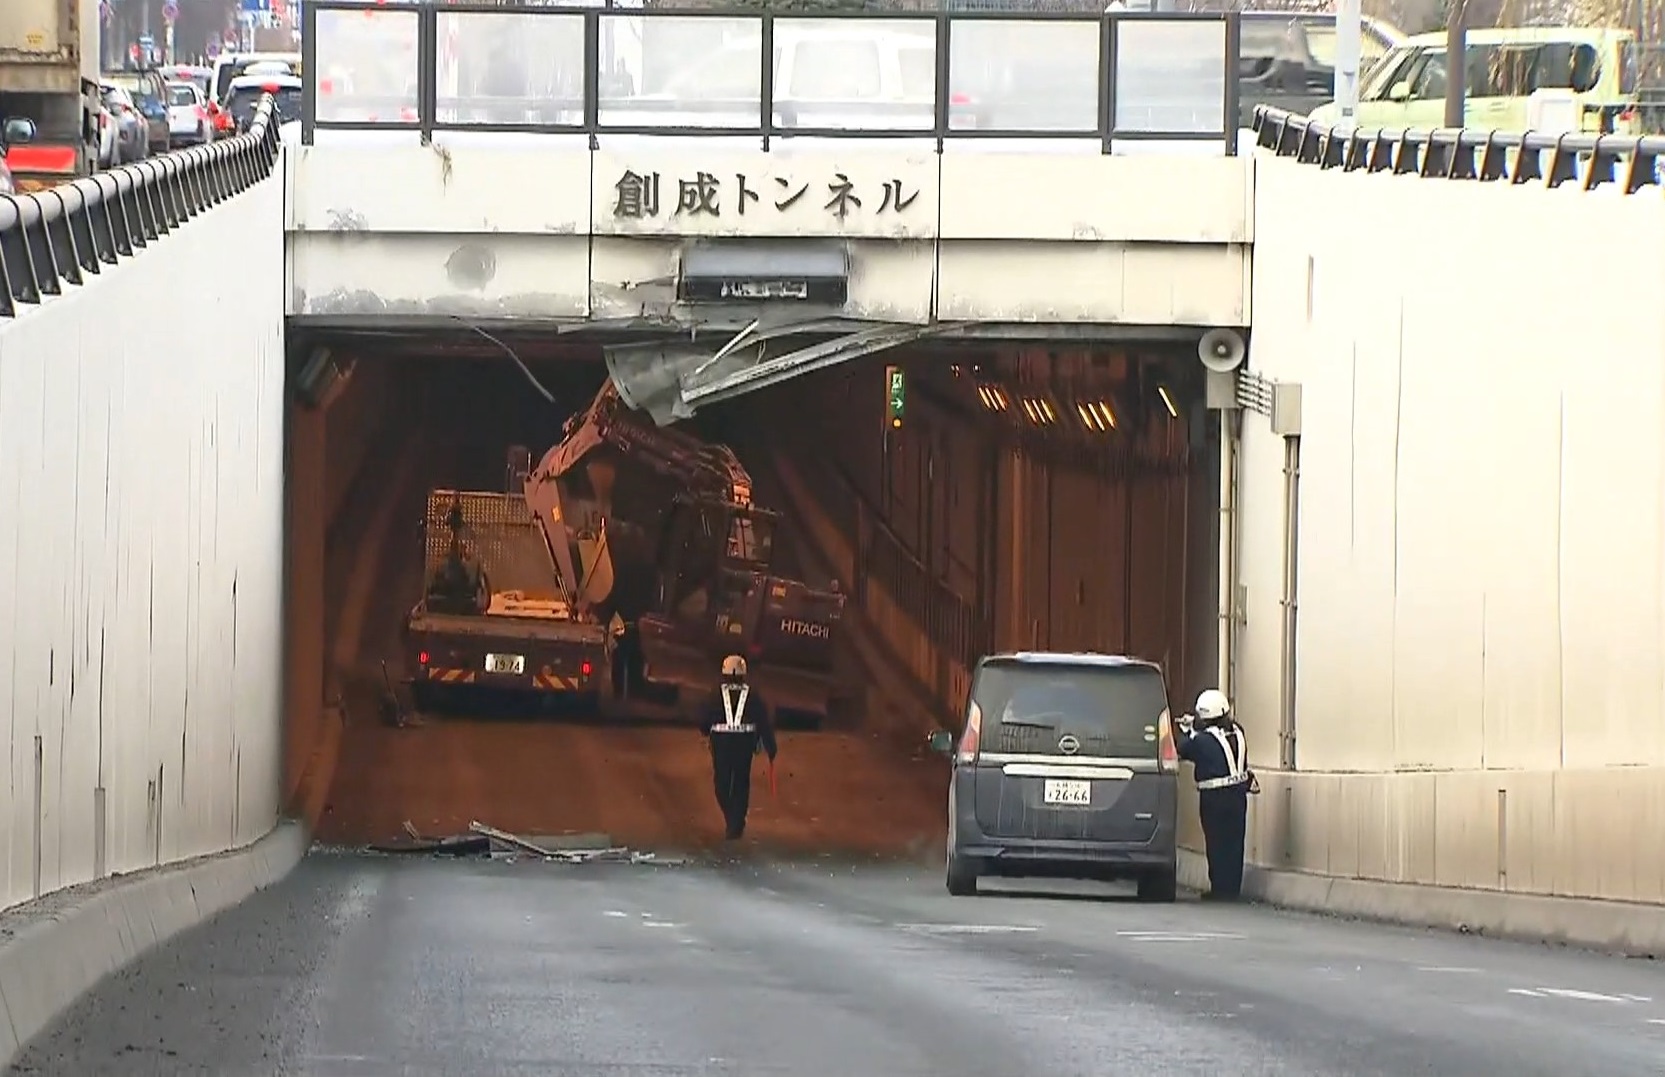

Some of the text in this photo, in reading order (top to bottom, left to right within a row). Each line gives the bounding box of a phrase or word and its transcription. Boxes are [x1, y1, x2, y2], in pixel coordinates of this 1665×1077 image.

[613, 169, 920, 217] 創成トンネル
[781, 619, 830, 639] HITACHI
